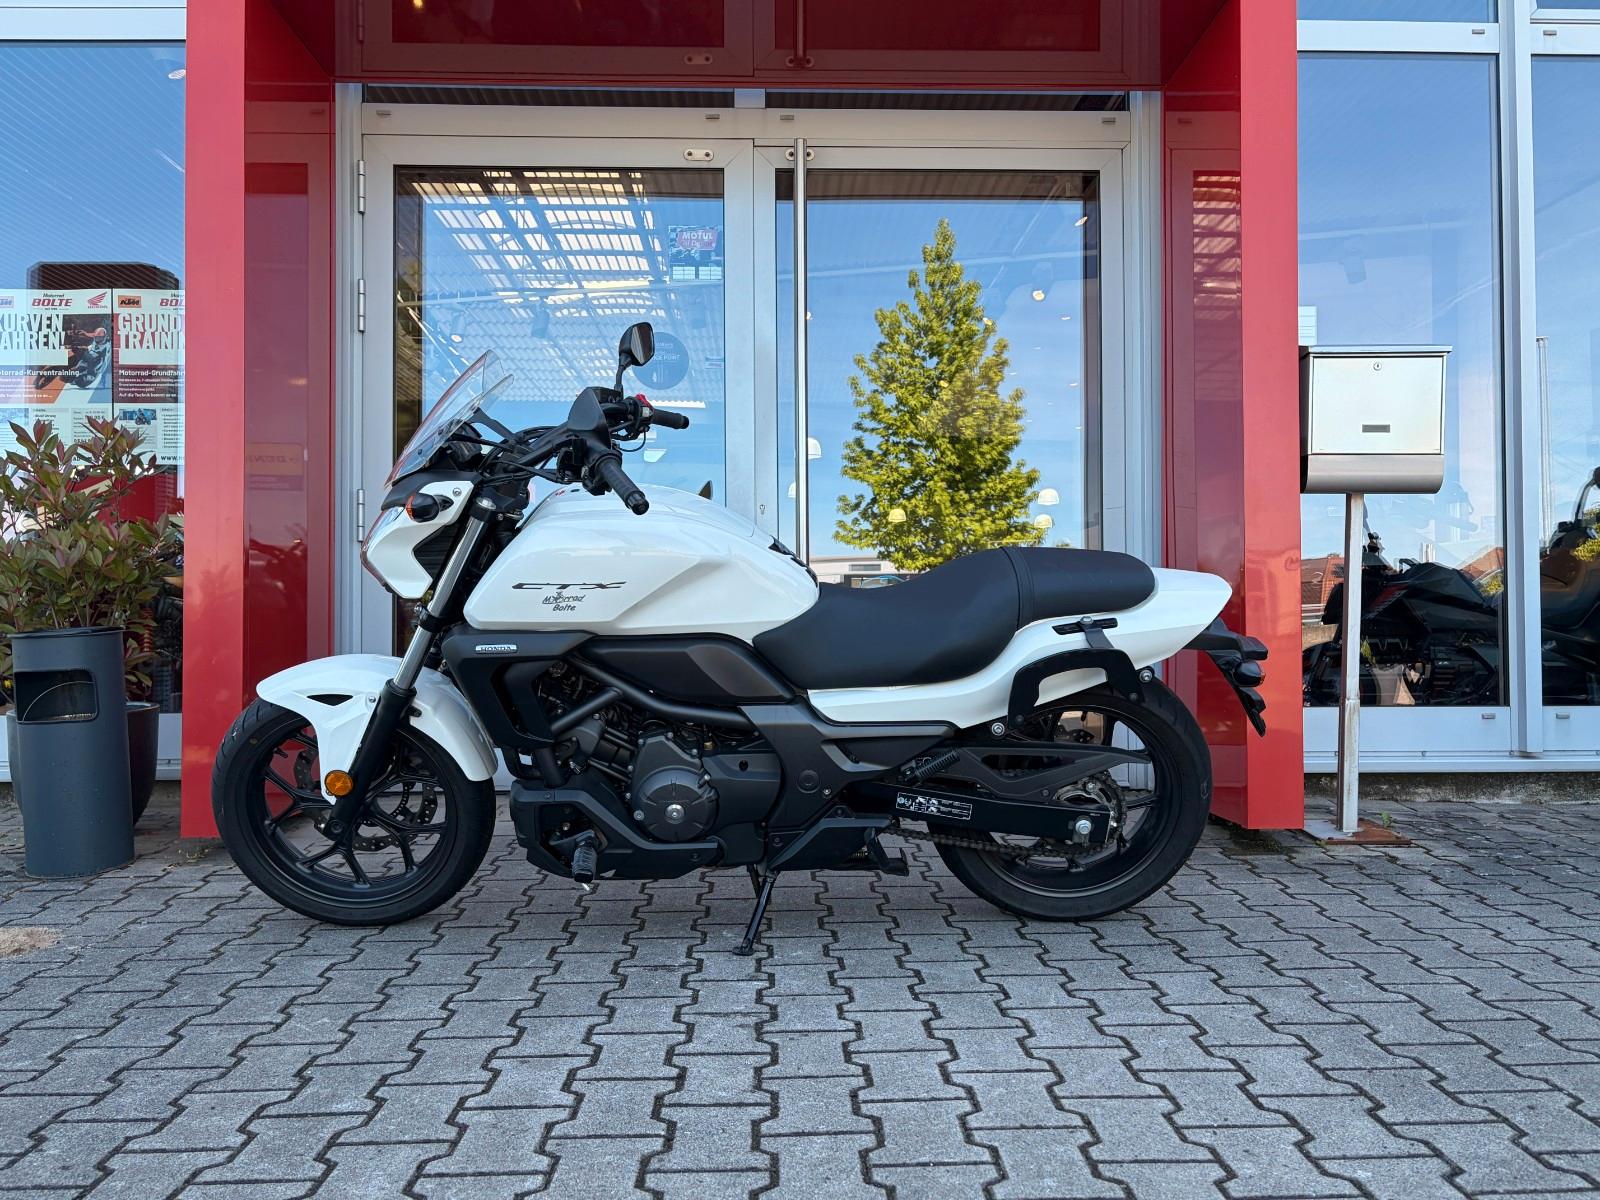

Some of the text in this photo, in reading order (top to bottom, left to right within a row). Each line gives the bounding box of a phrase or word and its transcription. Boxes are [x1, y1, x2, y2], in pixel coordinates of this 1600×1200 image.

[682, 231, 713, 240] MOTUL
[32, 298, 73, 307] BOLTE
[0, 369, 80, 377] torrad-Kurventraining
[512, 581, 626, 590] CTX
[552, 603, 576, 611] Bolte
